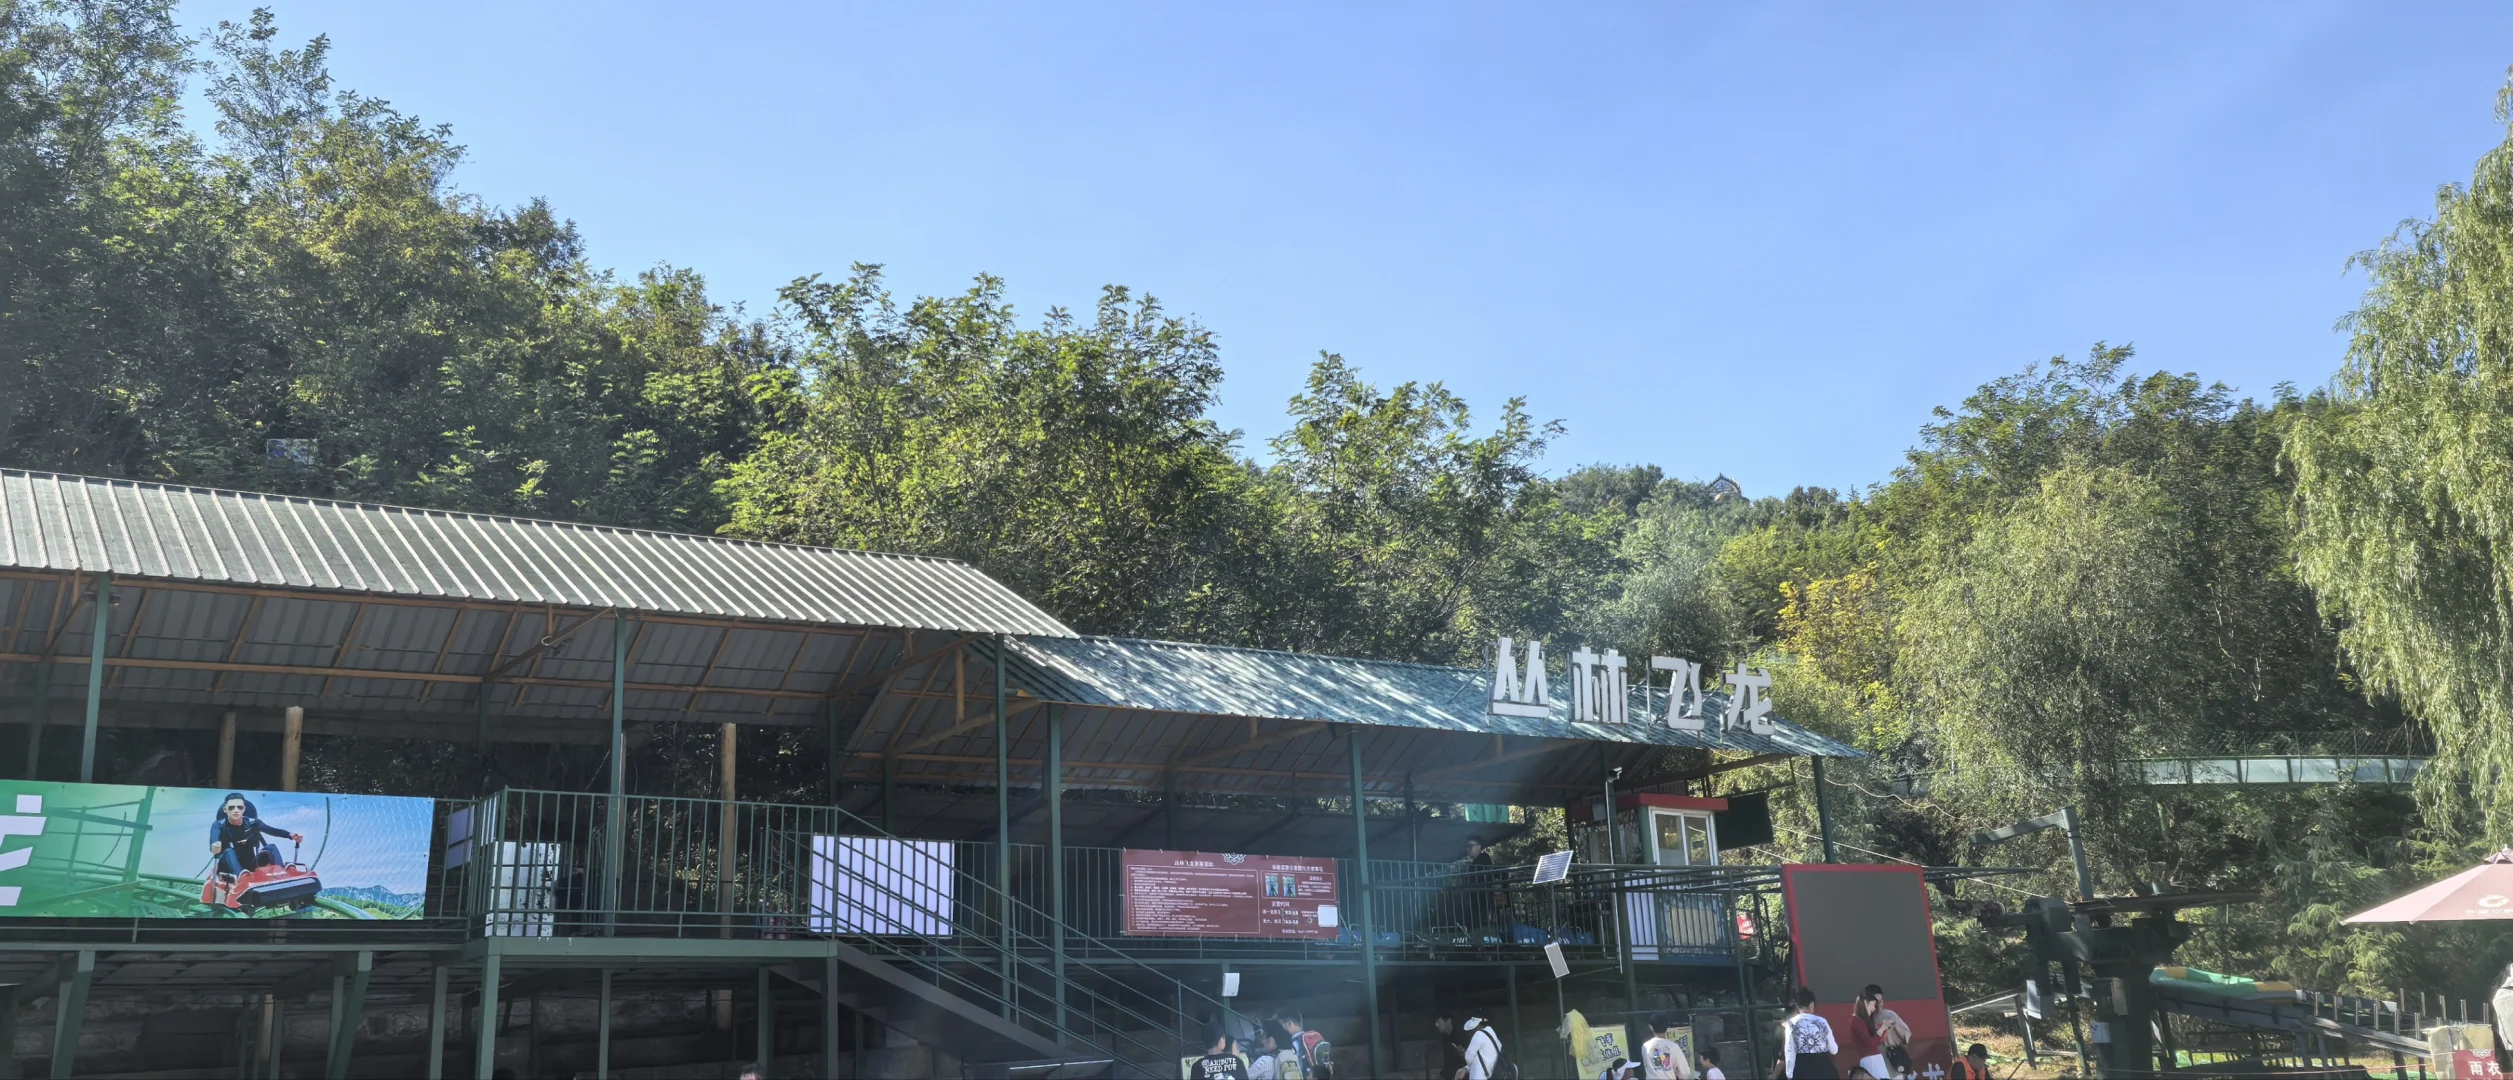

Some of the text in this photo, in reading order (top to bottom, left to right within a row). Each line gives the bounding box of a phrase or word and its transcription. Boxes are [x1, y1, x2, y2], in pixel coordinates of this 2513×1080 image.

[1491, 637, 1775, 735] 丛林飞龙
[2468, 1060, 2502, 1076] 雨衣
